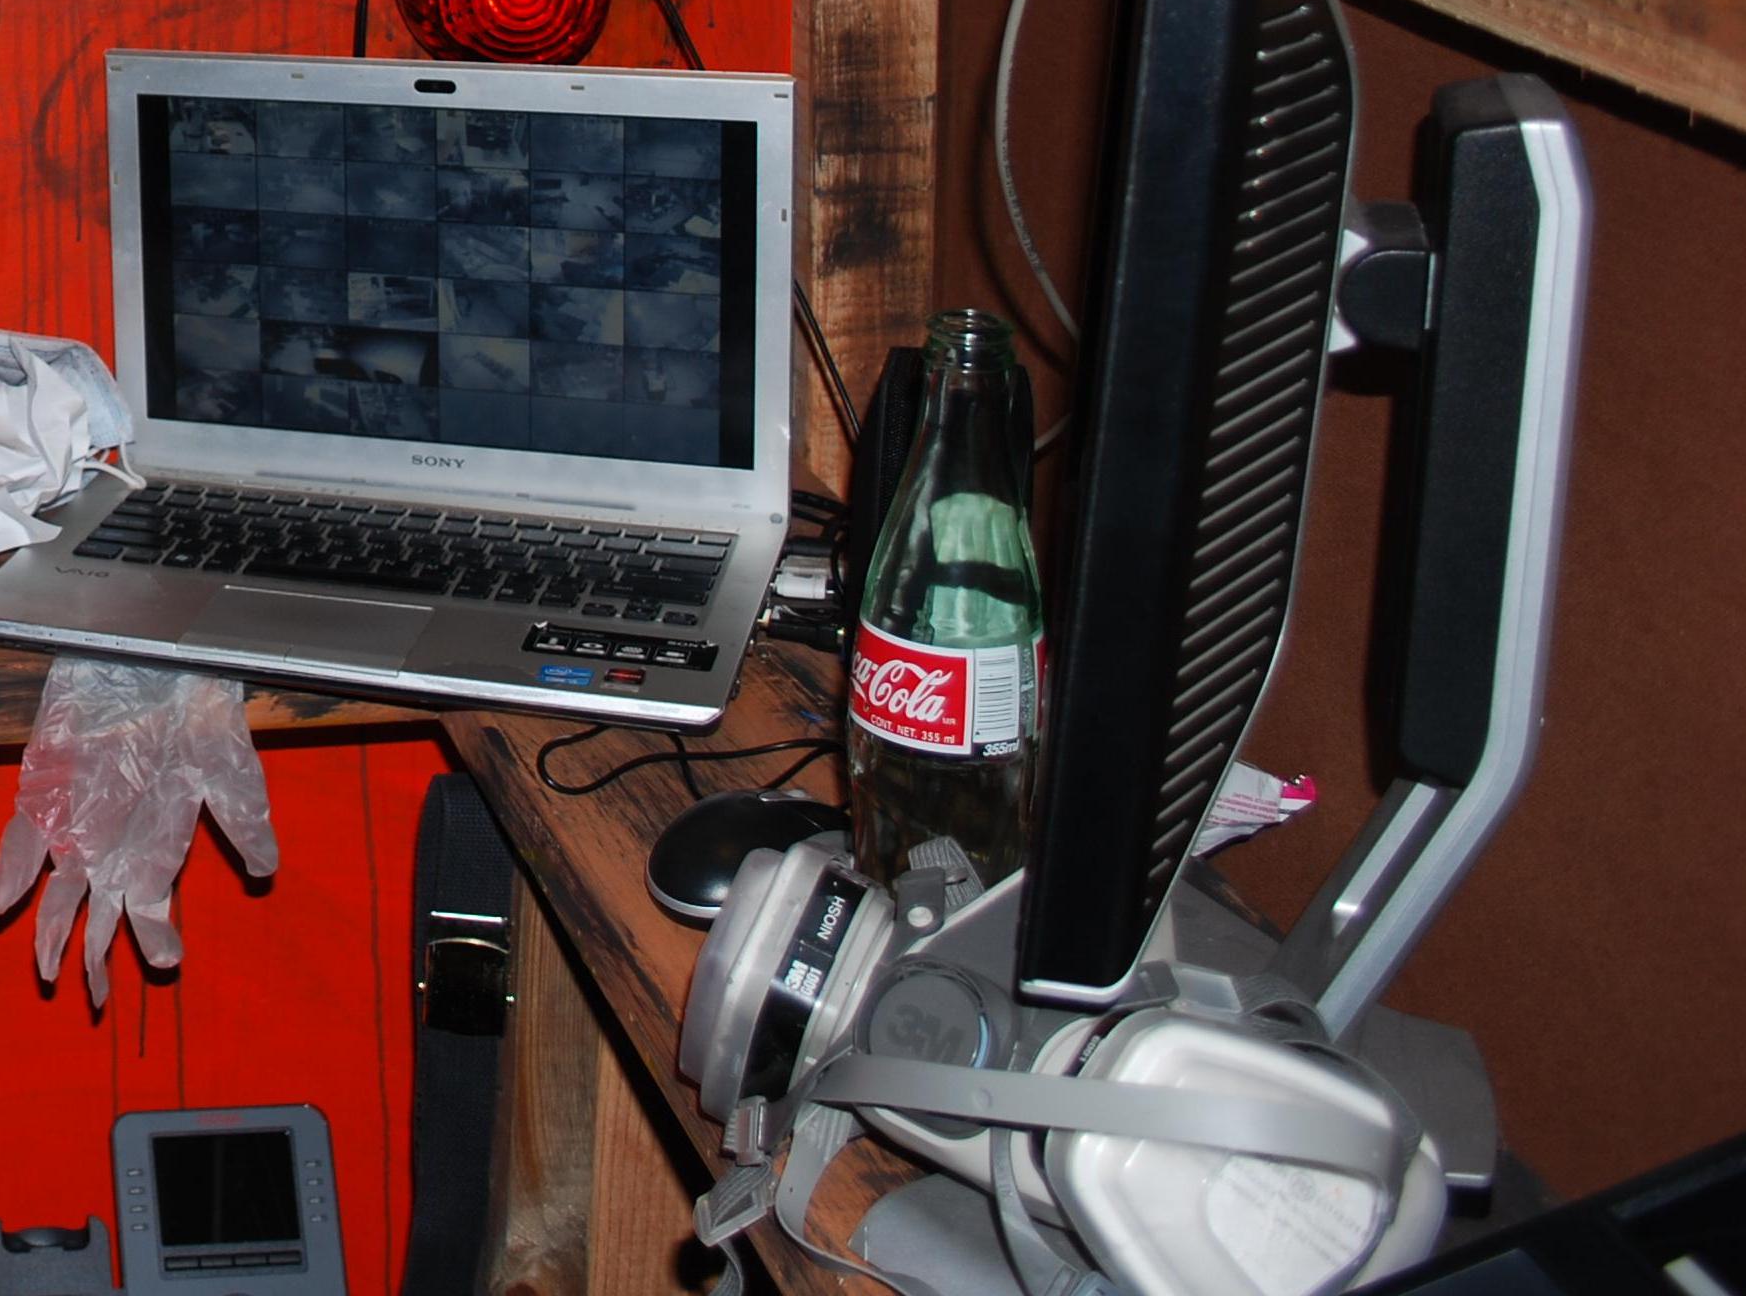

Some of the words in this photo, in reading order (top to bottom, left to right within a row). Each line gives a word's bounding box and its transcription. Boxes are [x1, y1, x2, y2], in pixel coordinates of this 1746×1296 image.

[411, 454, 465, 469] SONY
[870, 714, 894, 732] CONT.
[897, 724, 917, 740] NET.
[921, 731, 940, 743] 355
[944, 735, 956, 744] ml
[982, 739, 1020, 756] 355ml
[816, 895, 846, 941] NIOSH
[783, 959, 809, 991] 3M
